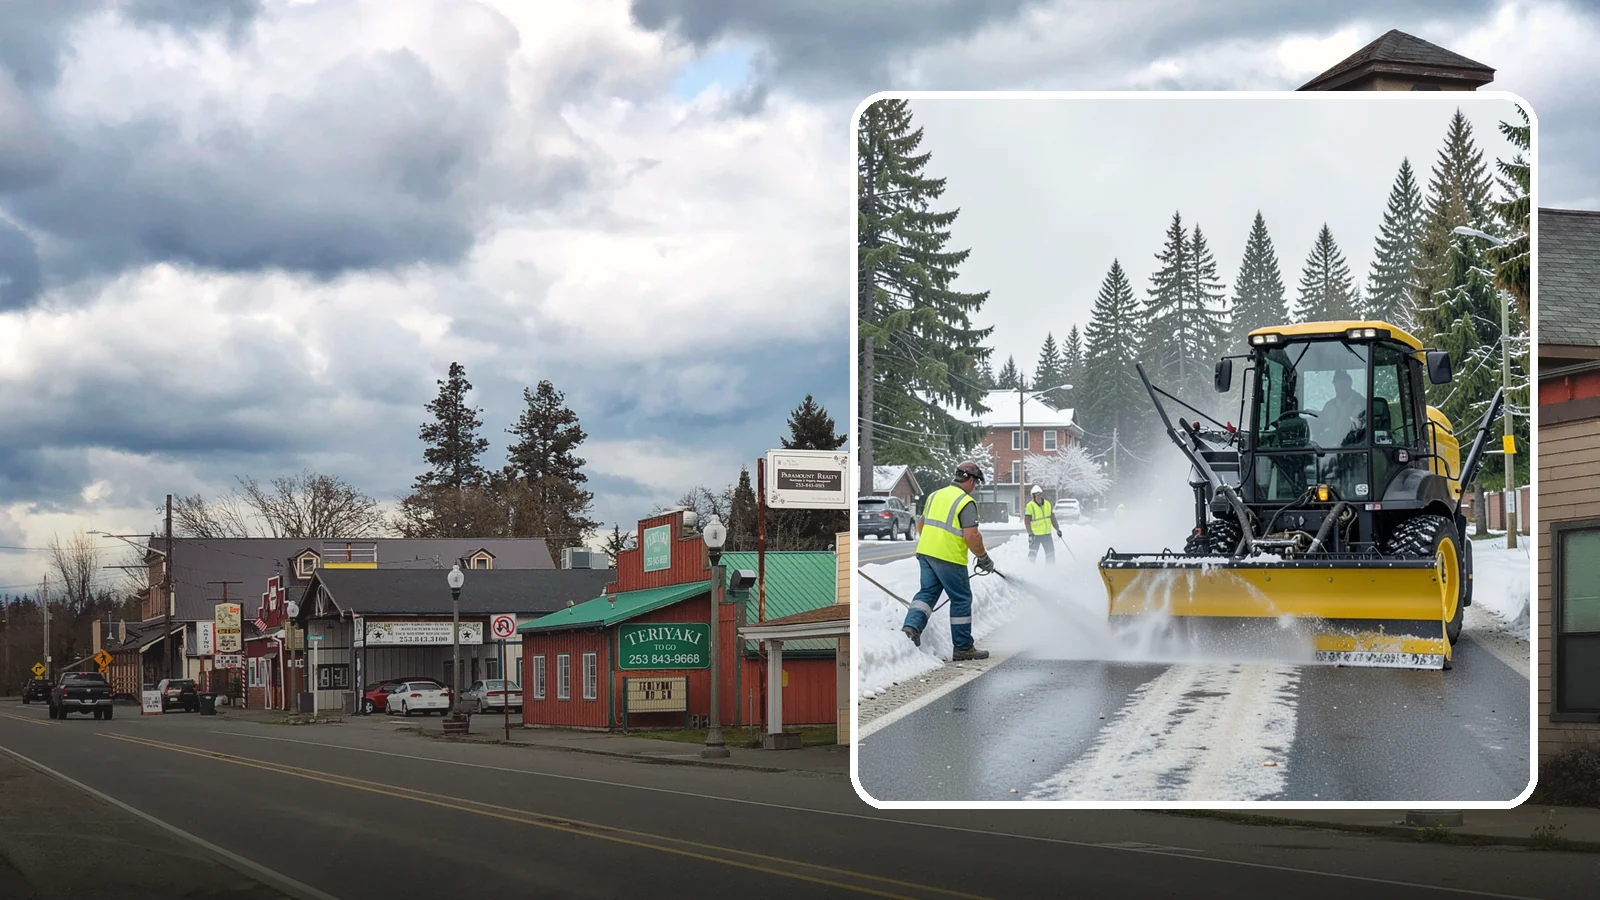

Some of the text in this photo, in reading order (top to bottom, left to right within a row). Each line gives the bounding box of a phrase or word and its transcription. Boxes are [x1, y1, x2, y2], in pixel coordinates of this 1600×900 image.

[624, 628, 702, 646] TERIYAKI
[629, 654, 700, 664] 253 843-9668
[639, 681, 672, 691] TERIYAKI
